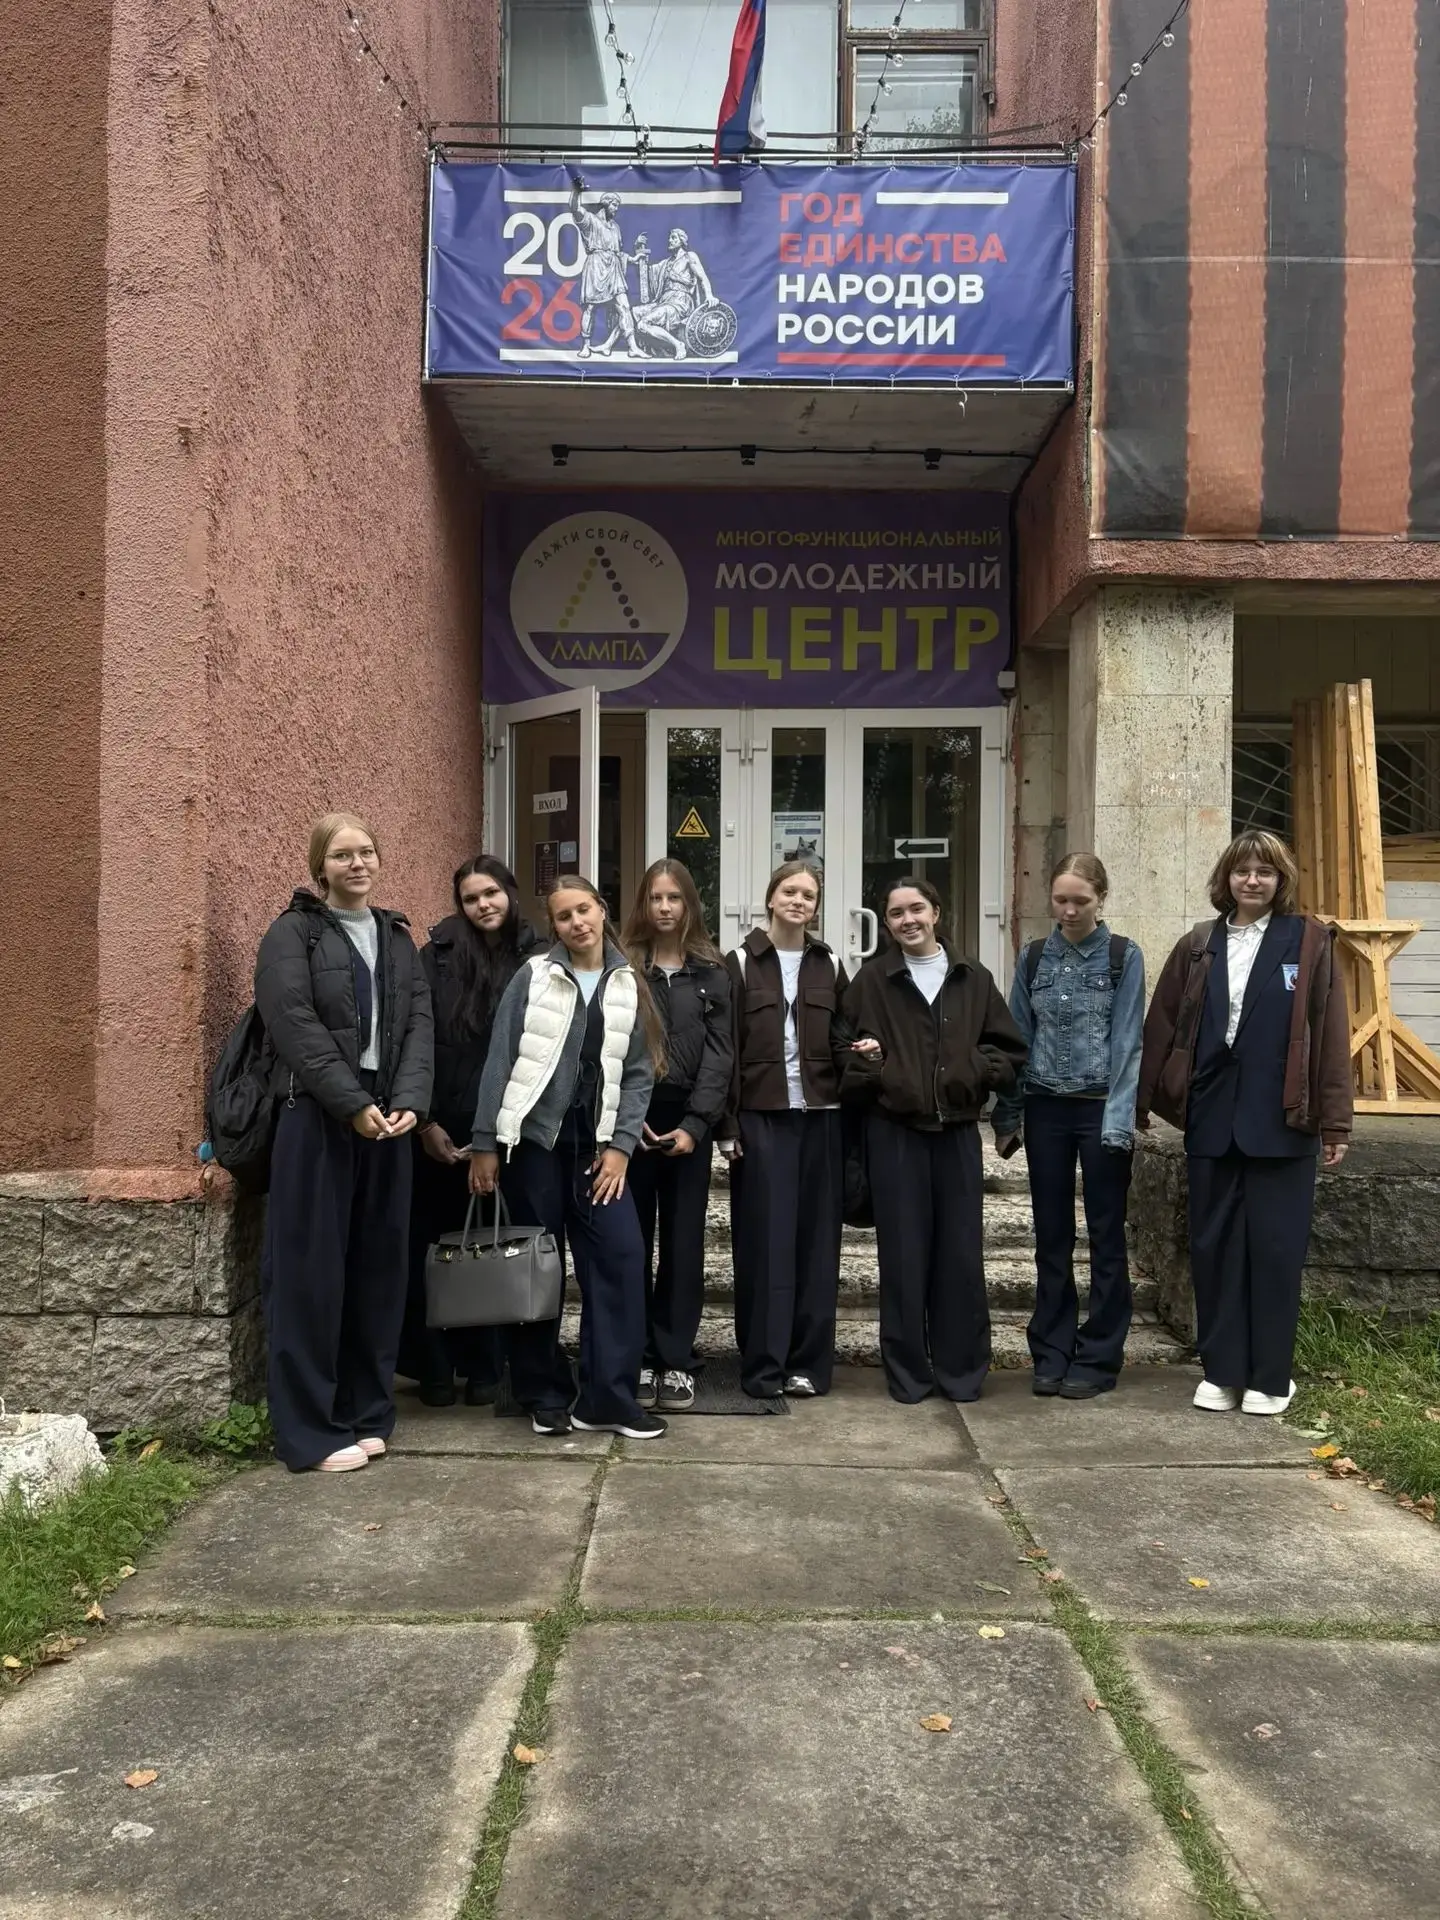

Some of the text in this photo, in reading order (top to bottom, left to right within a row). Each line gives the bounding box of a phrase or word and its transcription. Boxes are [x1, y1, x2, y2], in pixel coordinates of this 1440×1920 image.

[779, 193, 863, 227] ГОД
[503, 212, 586, 277] 20
[779, 232, 1007, 268] ЕДИНСТВА
[778, 273, 984, 308] НАРОДОВ
[501, 280, 582, 342] 26
[778, 313, 956, 346] РОССИИ
[534, 528, 665, 569] ЗАЖГИ СВОЙ СВЕТ
[716, 526, 1002, 549] МНОГОФУНКЦИОНАЛЬНЫЙ
[714, 556, 1001, 593] МОЛОДЕЖНЫЙ
[550, 640, 648, 662] ЛАМПА
[713, 606, 1000, 680] ЦЕНТР
[538, 797, 562, 810] ВХОД
